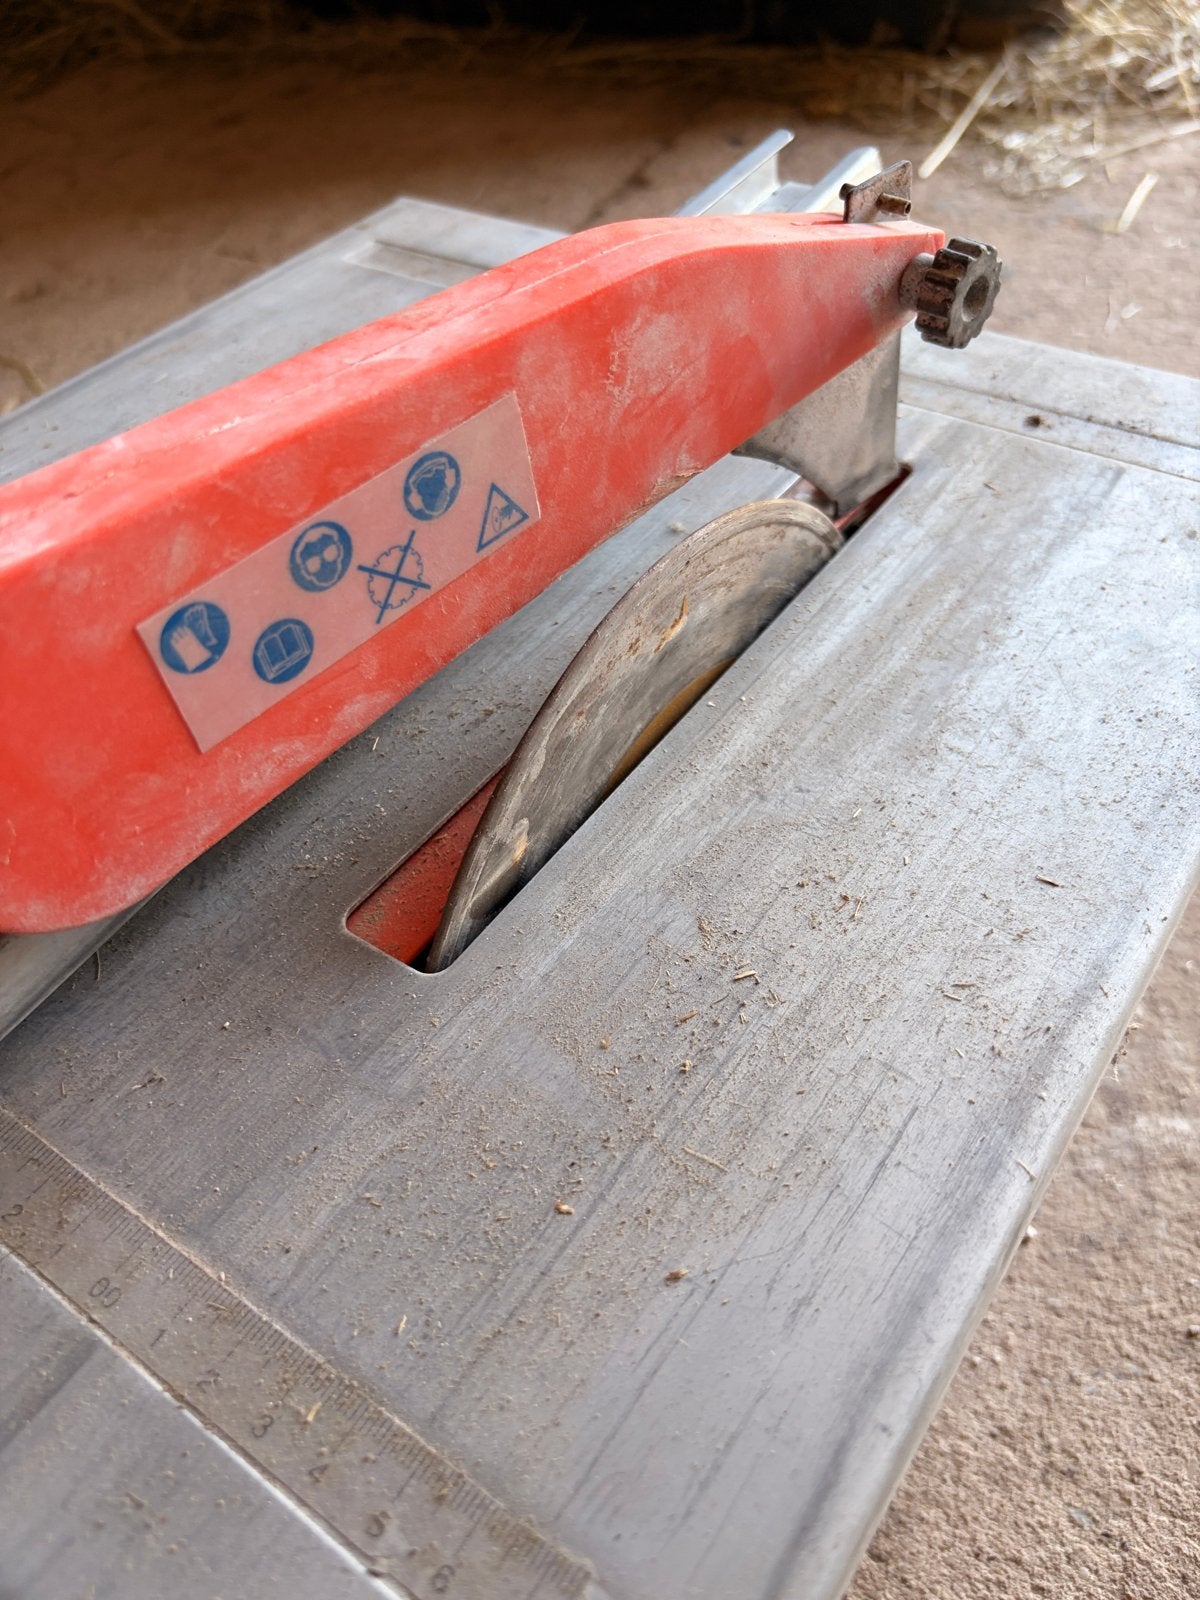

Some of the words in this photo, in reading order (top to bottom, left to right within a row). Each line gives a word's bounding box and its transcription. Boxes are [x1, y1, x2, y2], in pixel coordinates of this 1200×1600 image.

[0, 1203, 24, 1223] 2
[150, 1328, 167, 1347] 1
[251, 1413, 274, 1438] 3
[431, 1564, 456, 1593] 6
